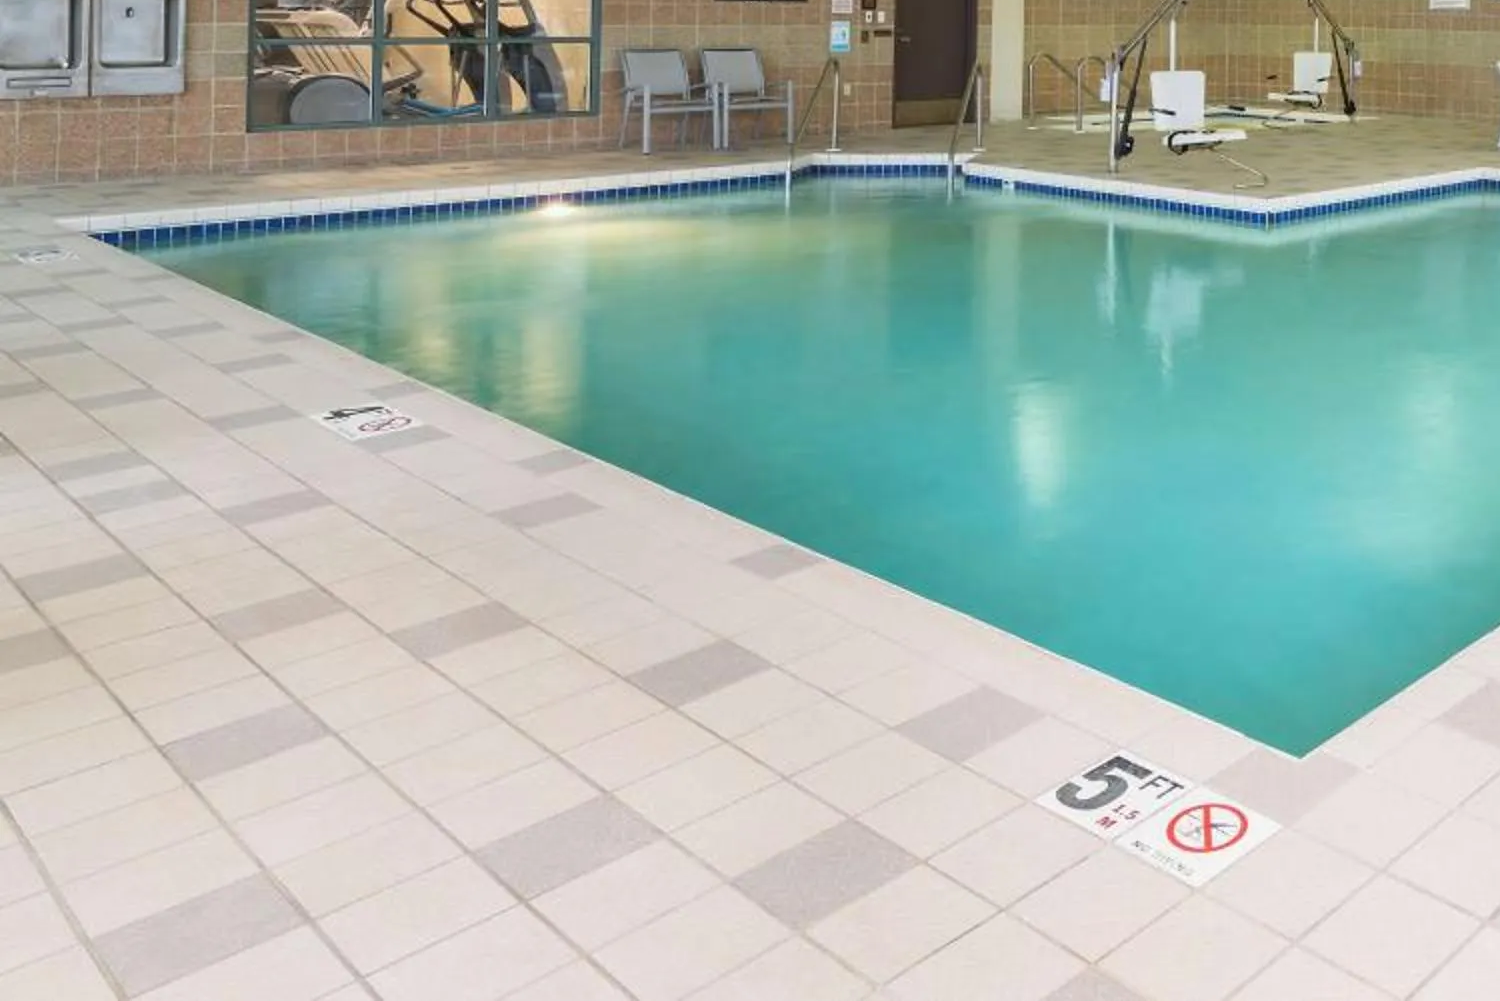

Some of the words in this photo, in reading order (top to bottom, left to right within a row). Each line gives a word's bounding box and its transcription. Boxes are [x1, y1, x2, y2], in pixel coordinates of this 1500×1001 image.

[1055, 755, 1153, 811] 5
[1138, 774, 1185, 800] FT
[1095, 816, 1118, 830] M
